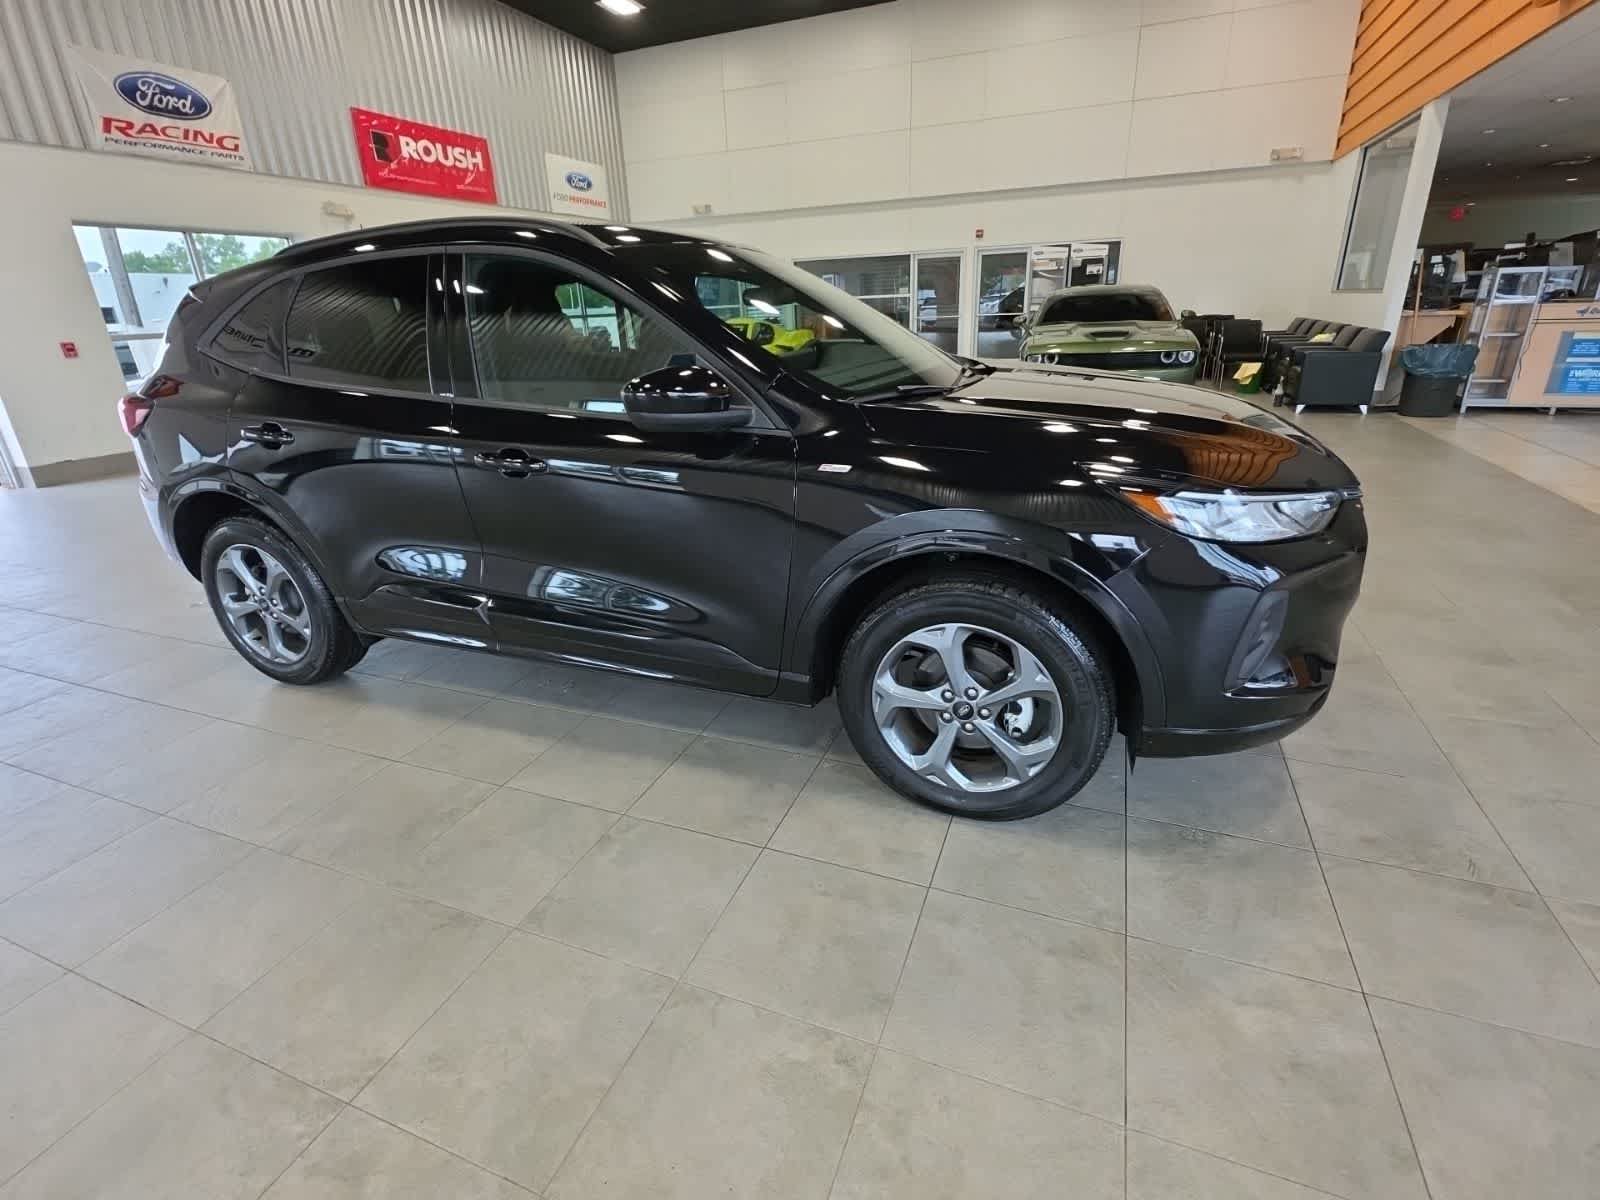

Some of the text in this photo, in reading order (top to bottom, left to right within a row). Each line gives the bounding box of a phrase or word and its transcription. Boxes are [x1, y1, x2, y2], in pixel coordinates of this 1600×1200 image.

[135, 77, 195, 114] Ford
[102, 116, 240, 152] RACING
[104, 136, 245, 161] PERFORMANCE PARTS
[399, 135, 485, 172] ROUSH
